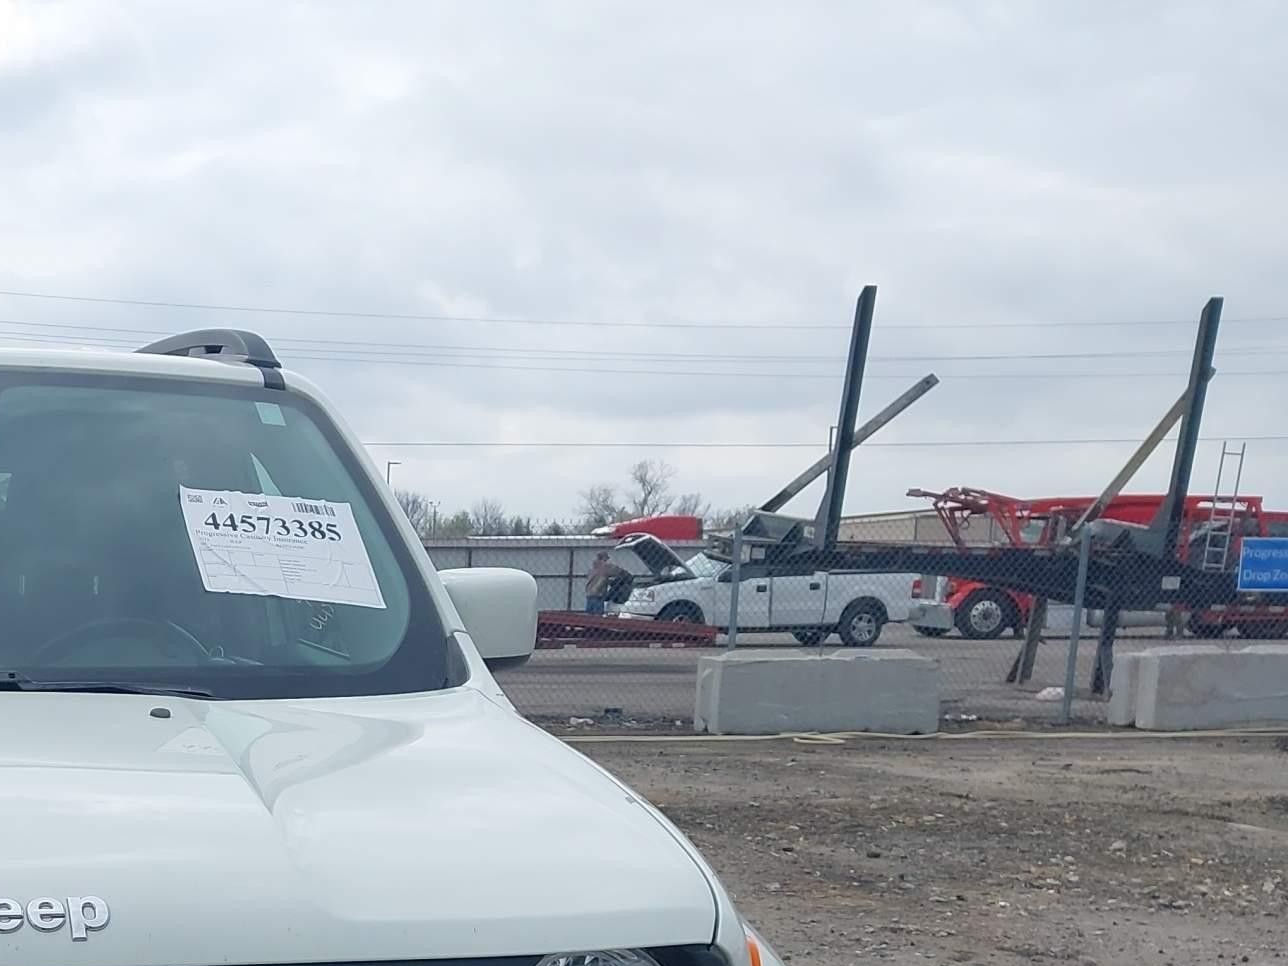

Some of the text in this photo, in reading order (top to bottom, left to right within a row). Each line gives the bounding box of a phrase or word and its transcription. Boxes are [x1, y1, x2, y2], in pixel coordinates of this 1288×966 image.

[204, 512, 342, 541] 44573385
[195, 529, 239, 539] Progressive
[1243, 569, 1271, 583] Drop
